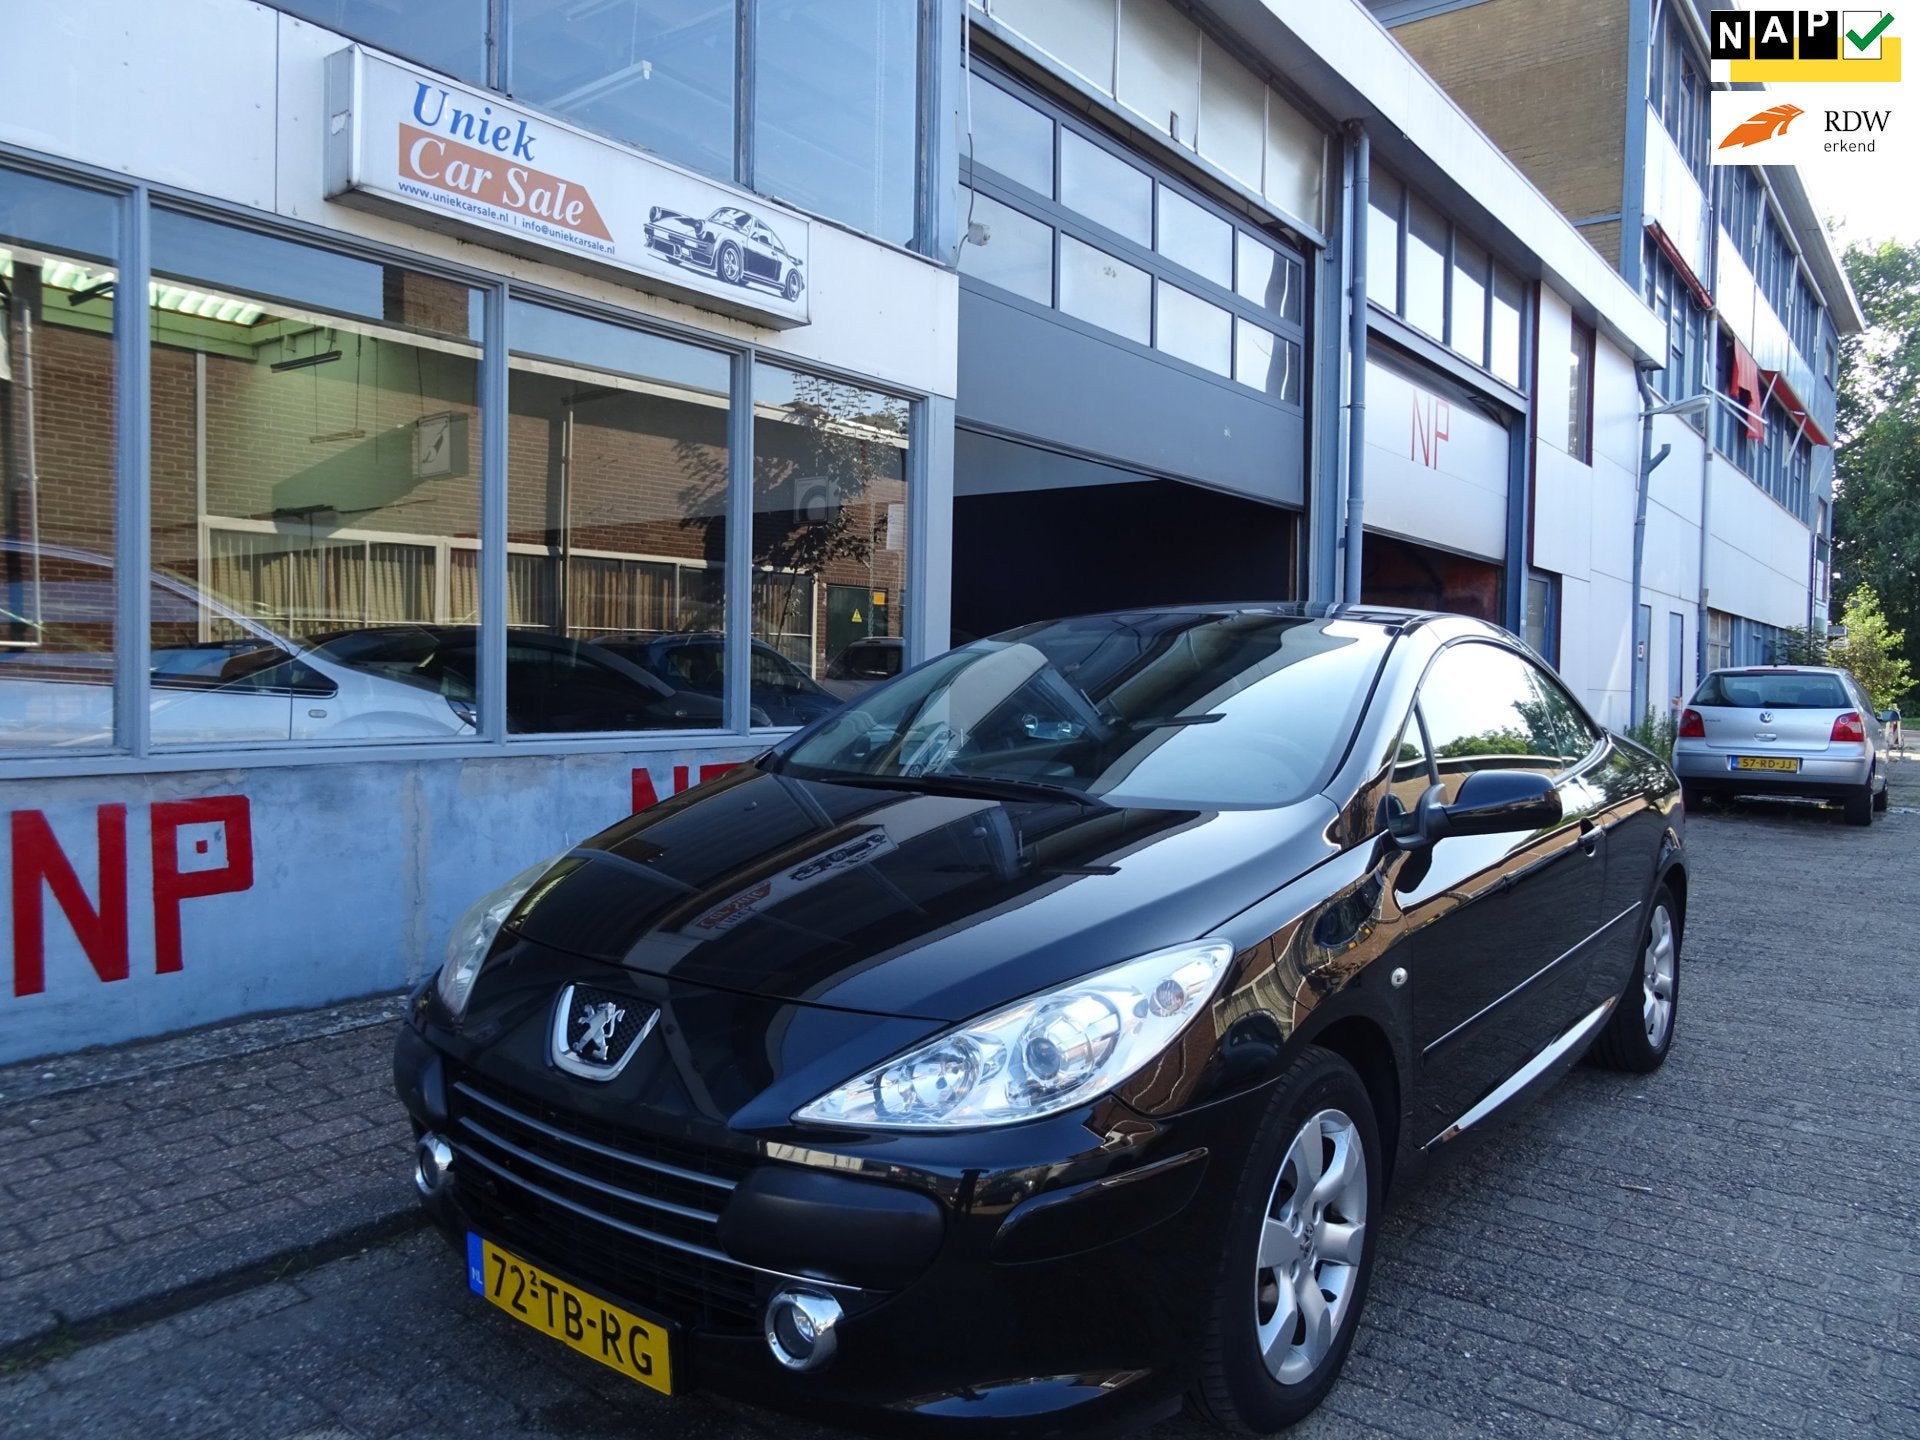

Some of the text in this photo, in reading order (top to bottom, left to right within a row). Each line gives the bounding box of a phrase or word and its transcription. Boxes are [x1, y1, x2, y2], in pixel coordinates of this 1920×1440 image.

[413, 81, 536, 162] Uniek
[398, 181, 509, 223] www.uniekcarsale.nl
[522, 217, 616, 255] info@uniekcarsale.nl
[409, 137, 584, 226] Car Sale
[1411, 388, 1449, 471] NP
[11, 794, 254, 998] NP
